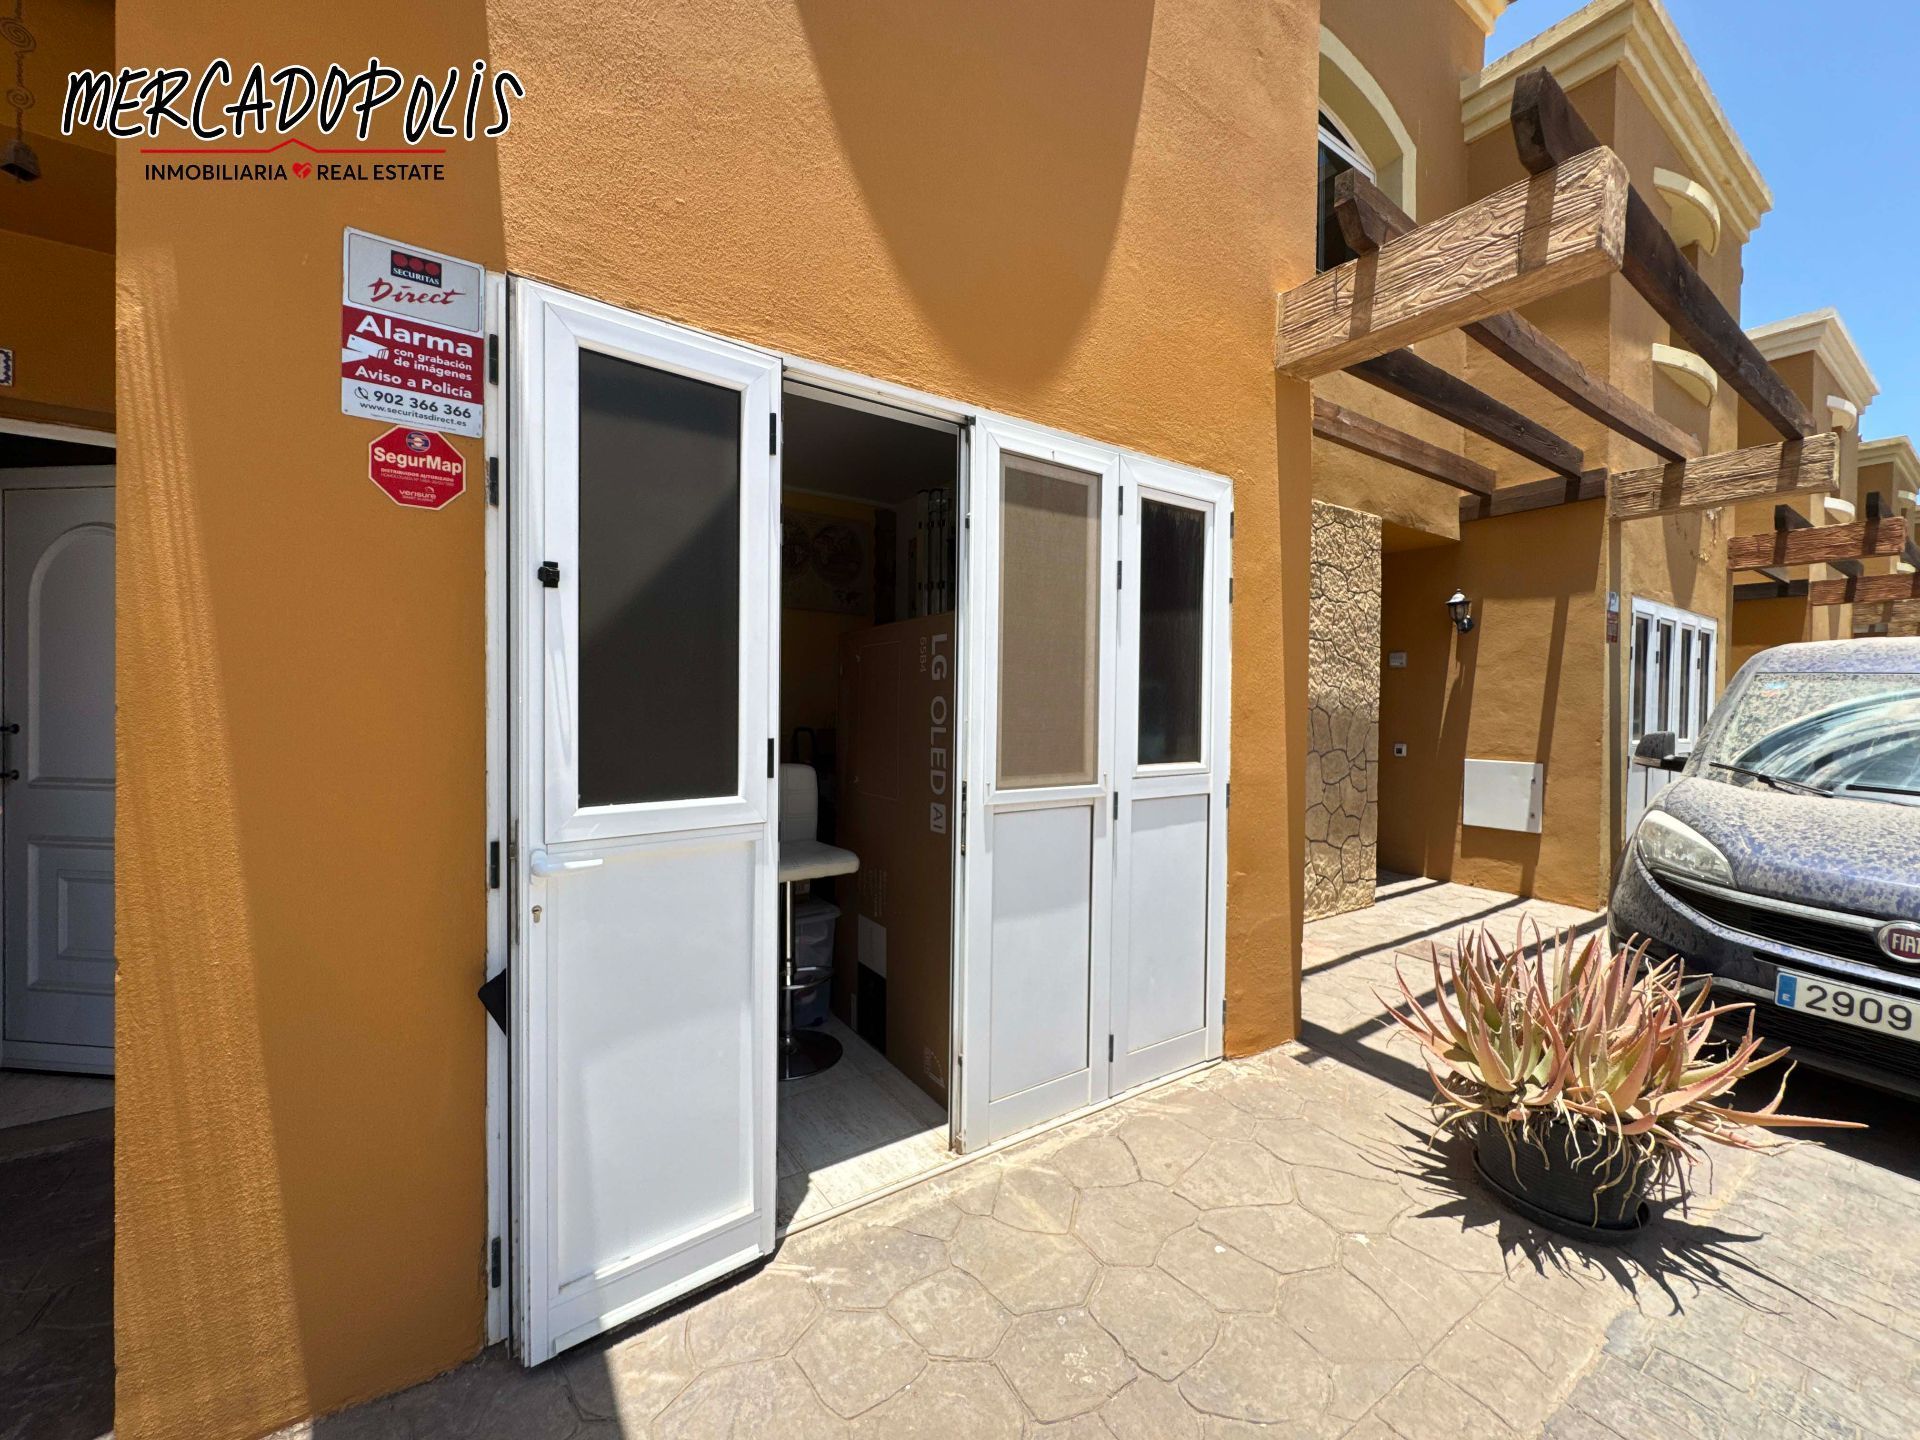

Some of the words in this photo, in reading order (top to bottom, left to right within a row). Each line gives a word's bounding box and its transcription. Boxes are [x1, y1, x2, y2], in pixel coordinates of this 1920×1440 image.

[368, 277, 466, 304] Direct
[393, 267, 440, 285] SECURITAS
[355, 315, 473, 358] Alarma
[393, 357, 410, 367] de
[414, 361, 472, 381] imágenes
[394, 348, 414, 358] con
[418, 354, 472, 371] grabación
[355, 365, 401, 385] Aviso
[407, 378, 416, 388] a
[422, 379, 472, 399] Policía
[360, 402, 467, 427] www.securitasdirect.es
[374, 390, 404, 406] 902
[409, 398, 438, 412] 366
[443, 404, 471, 419] 366
[374, 446, 462, 475] SegurMap
[931, 633, 948, 681] LG
[930, 696, 947, 795] OLED
[1805, 985, 1912, 1031] 2909
